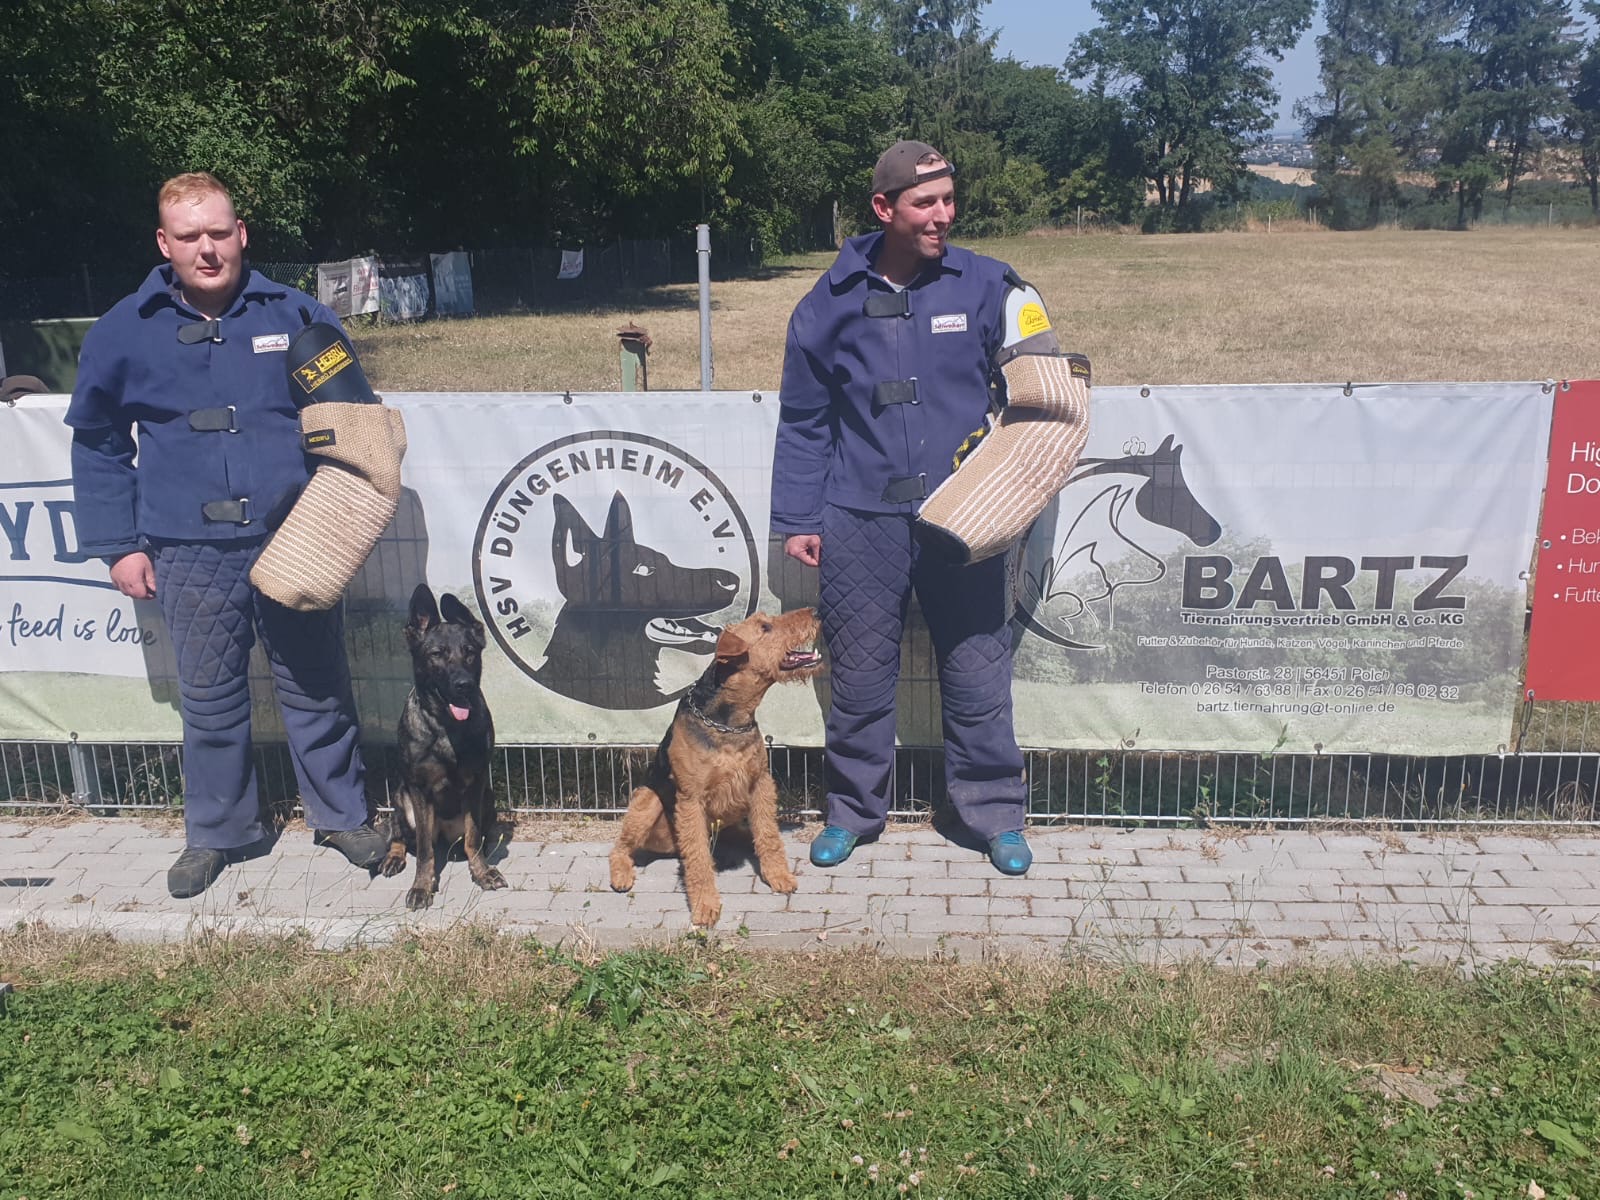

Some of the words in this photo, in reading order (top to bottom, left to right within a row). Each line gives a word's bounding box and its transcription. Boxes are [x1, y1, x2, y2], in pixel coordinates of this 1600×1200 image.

[489, 447, 685, 558] DÜNGENHEIM
[689, 487, 736, 554] E.V.
[1181, 555, 1469, 611] BARTZ
[489, 575, 532, 640] HSV
[1181, 612, 1341, 627] Tiernahrungsvertrieb
[1345, 614, 1392, 626] GmbH
[1397, 615, 1409, 627] &
[1413, 615, 1436, 626] Co.
[1440, 613, 1465, 625] KG
[7, 602, 65, 647] feed
[73, 618, 96, 641] is
[106, 607, 157, 646] love
[1137, 635, 1168, 647] Futter
[1168, 636, 1177, 647] &
[1178, 635, 1223, 648] Zubehör
[1224, 637, 1239, 648] für
[1240, 637, 1275, 649] Hunde,
[1276, 638, 1315, 650] Katzen,
[1352, 638, 1407, 650] Kaninchen
[1407, 637, 1426, 648] und
[1427, 637, 1464, 649] Pferde
[1206, 665, 1271, 680] Pastorstr.
[1274, 667, 1293, 679] 28
[1304, 667, 1347, 681] 56451
[1350, 668, 1390, 682] Polch
[1138, 682, 1188, 696] Telefon
[1191, 683, 1200, 696] 0
[1203, 683, 1221, 696] 26
[1224, 684, 1242, 696] 54
[1274, 684, 1292, 697] 88
[1304, 685, 1330, 698] Fax
[1334, 685, 1343, 698] 0
[1346, 685, 1365, 699] 26
[1368, 685, 1385, 698] 54
[1396, 684, 1415, 697] 96
[1417, 685, 1437, 699] 02
[1440, 686, 1460, 700] 32
[1196, 701, 1396, 716] bartz.tiernahrung@t-online.de
